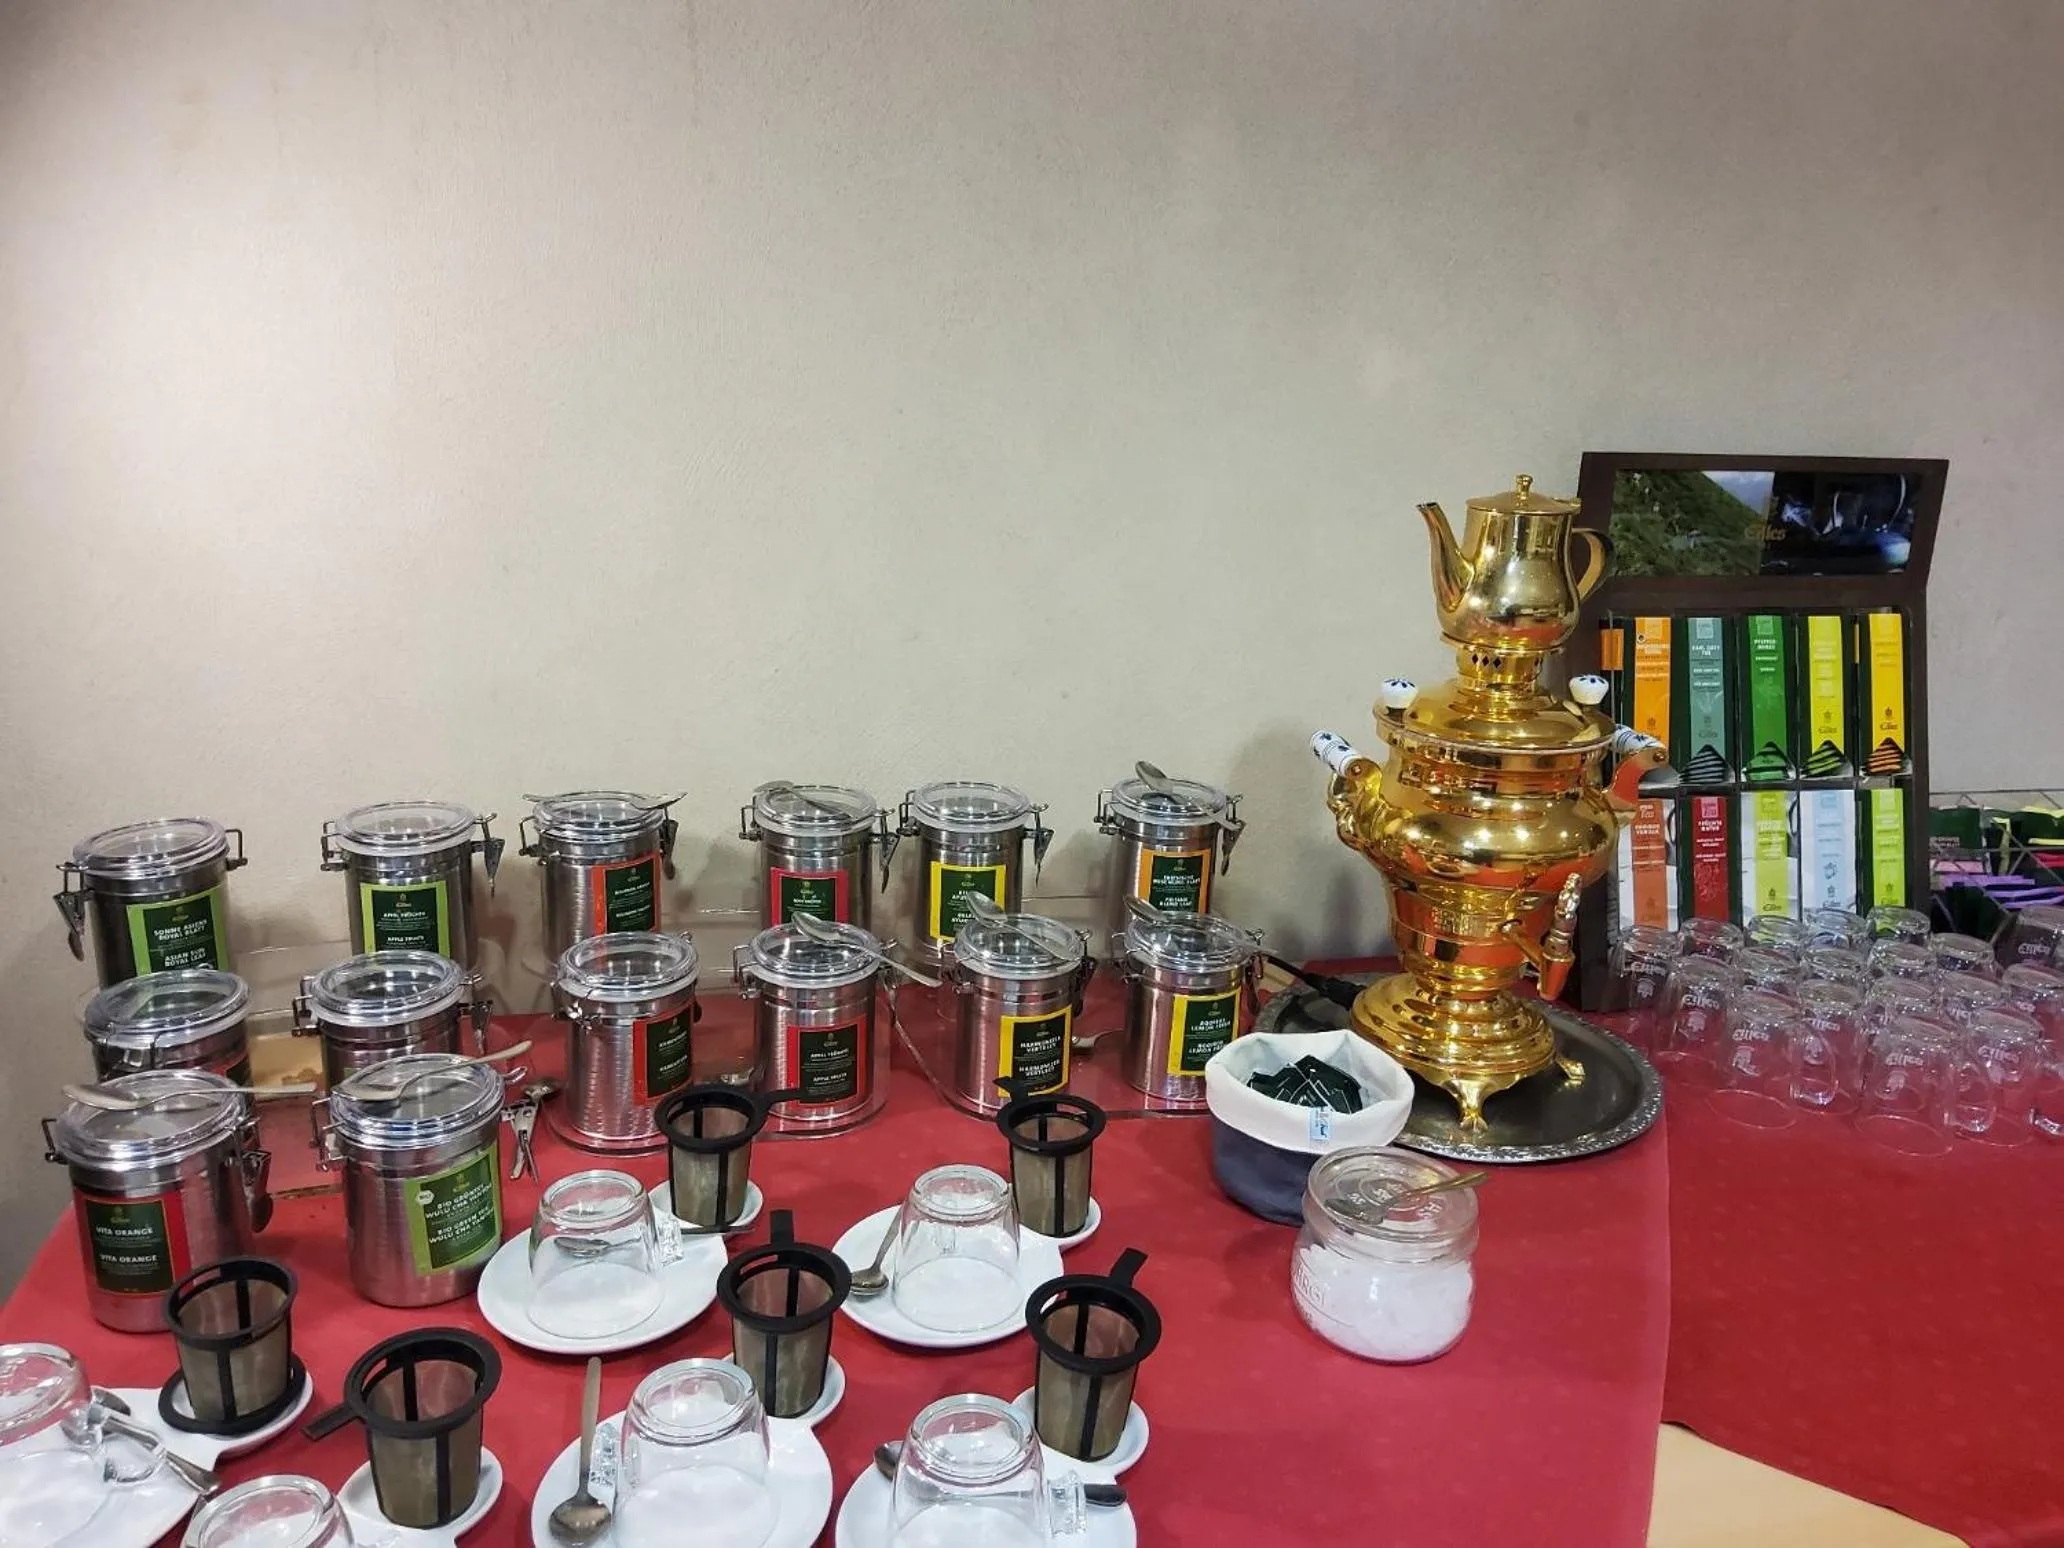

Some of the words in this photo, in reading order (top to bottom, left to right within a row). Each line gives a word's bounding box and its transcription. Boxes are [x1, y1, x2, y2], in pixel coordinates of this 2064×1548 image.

[96, 1226, 113, 1235] VITA
[114, 1226, 154, 1236] ORANGE
[100, 1254, 118, 1262] VITA
[119, 1255, 158, 1264] ORANGE
